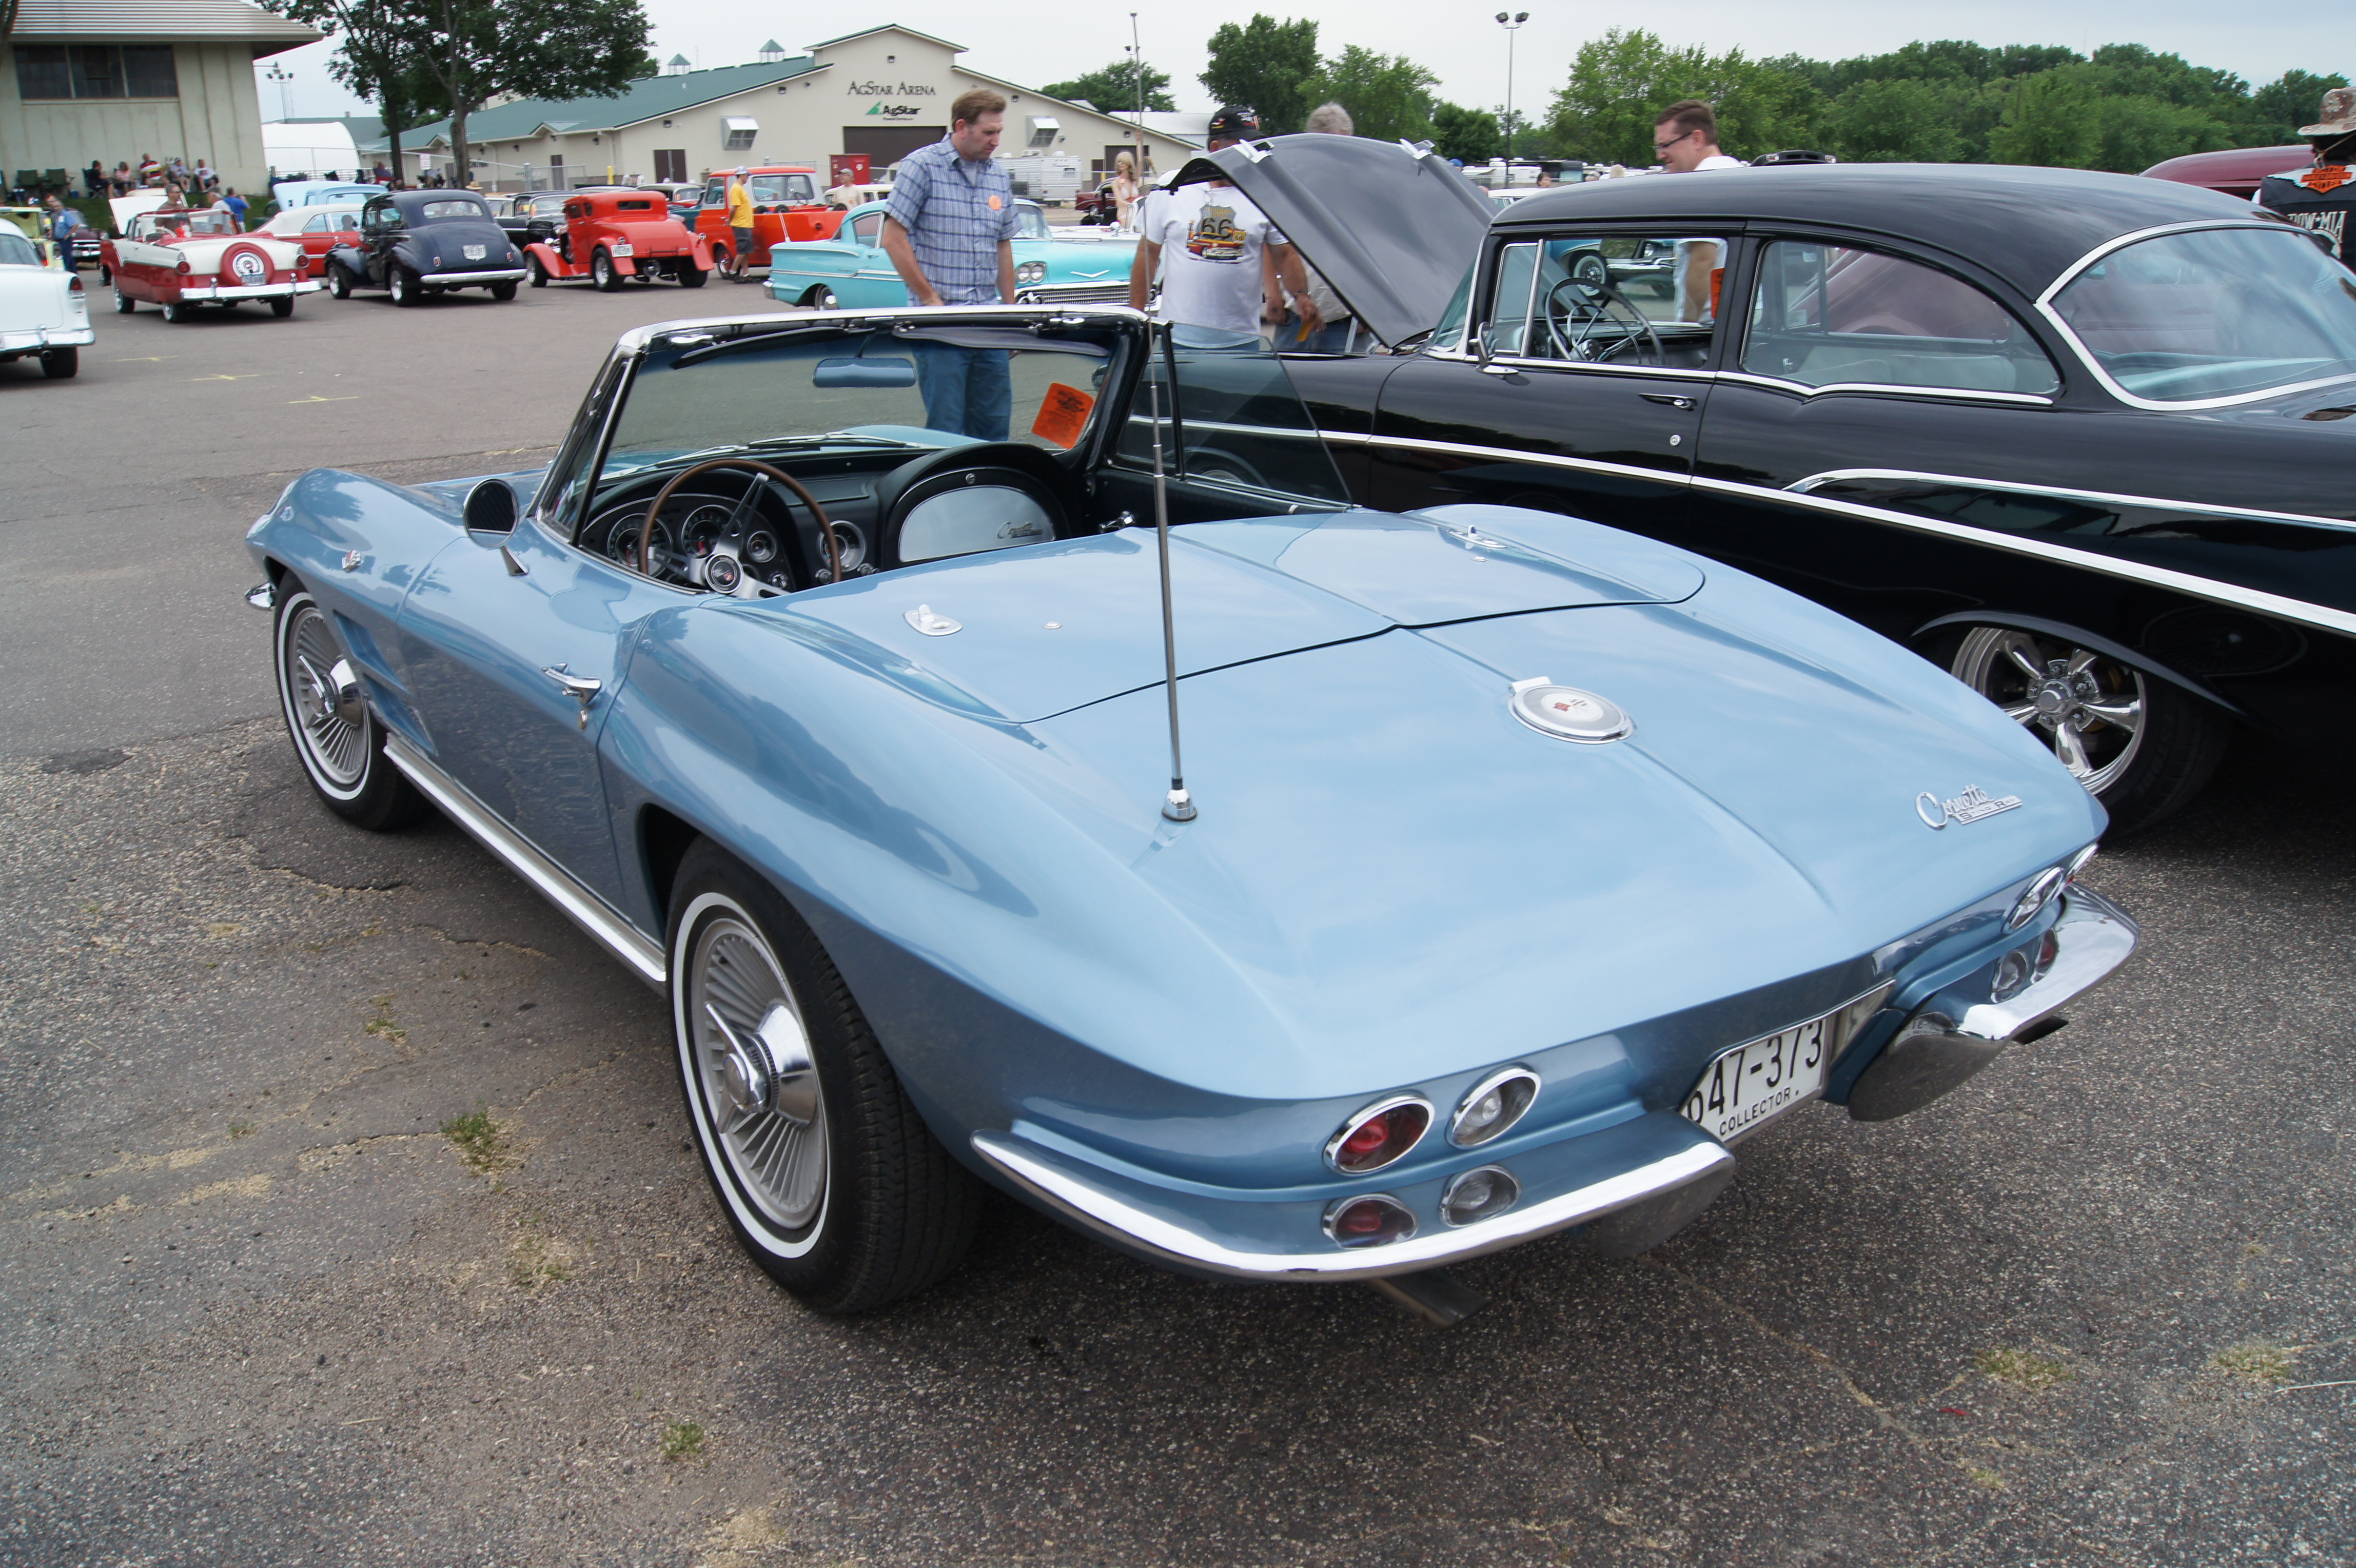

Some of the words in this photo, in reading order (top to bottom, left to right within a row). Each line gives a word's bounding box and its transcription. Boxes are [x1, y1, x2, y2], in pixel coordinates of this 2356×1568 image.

[883, 105, 921, 116] AgStar
[1201, 217, 1233, 239] 66
[2318, 210, 2348, 243] MIA
[1915, 784, 1995, 831] Corvette
[1719, 1087, 1791, 1135] COLLECTOR
